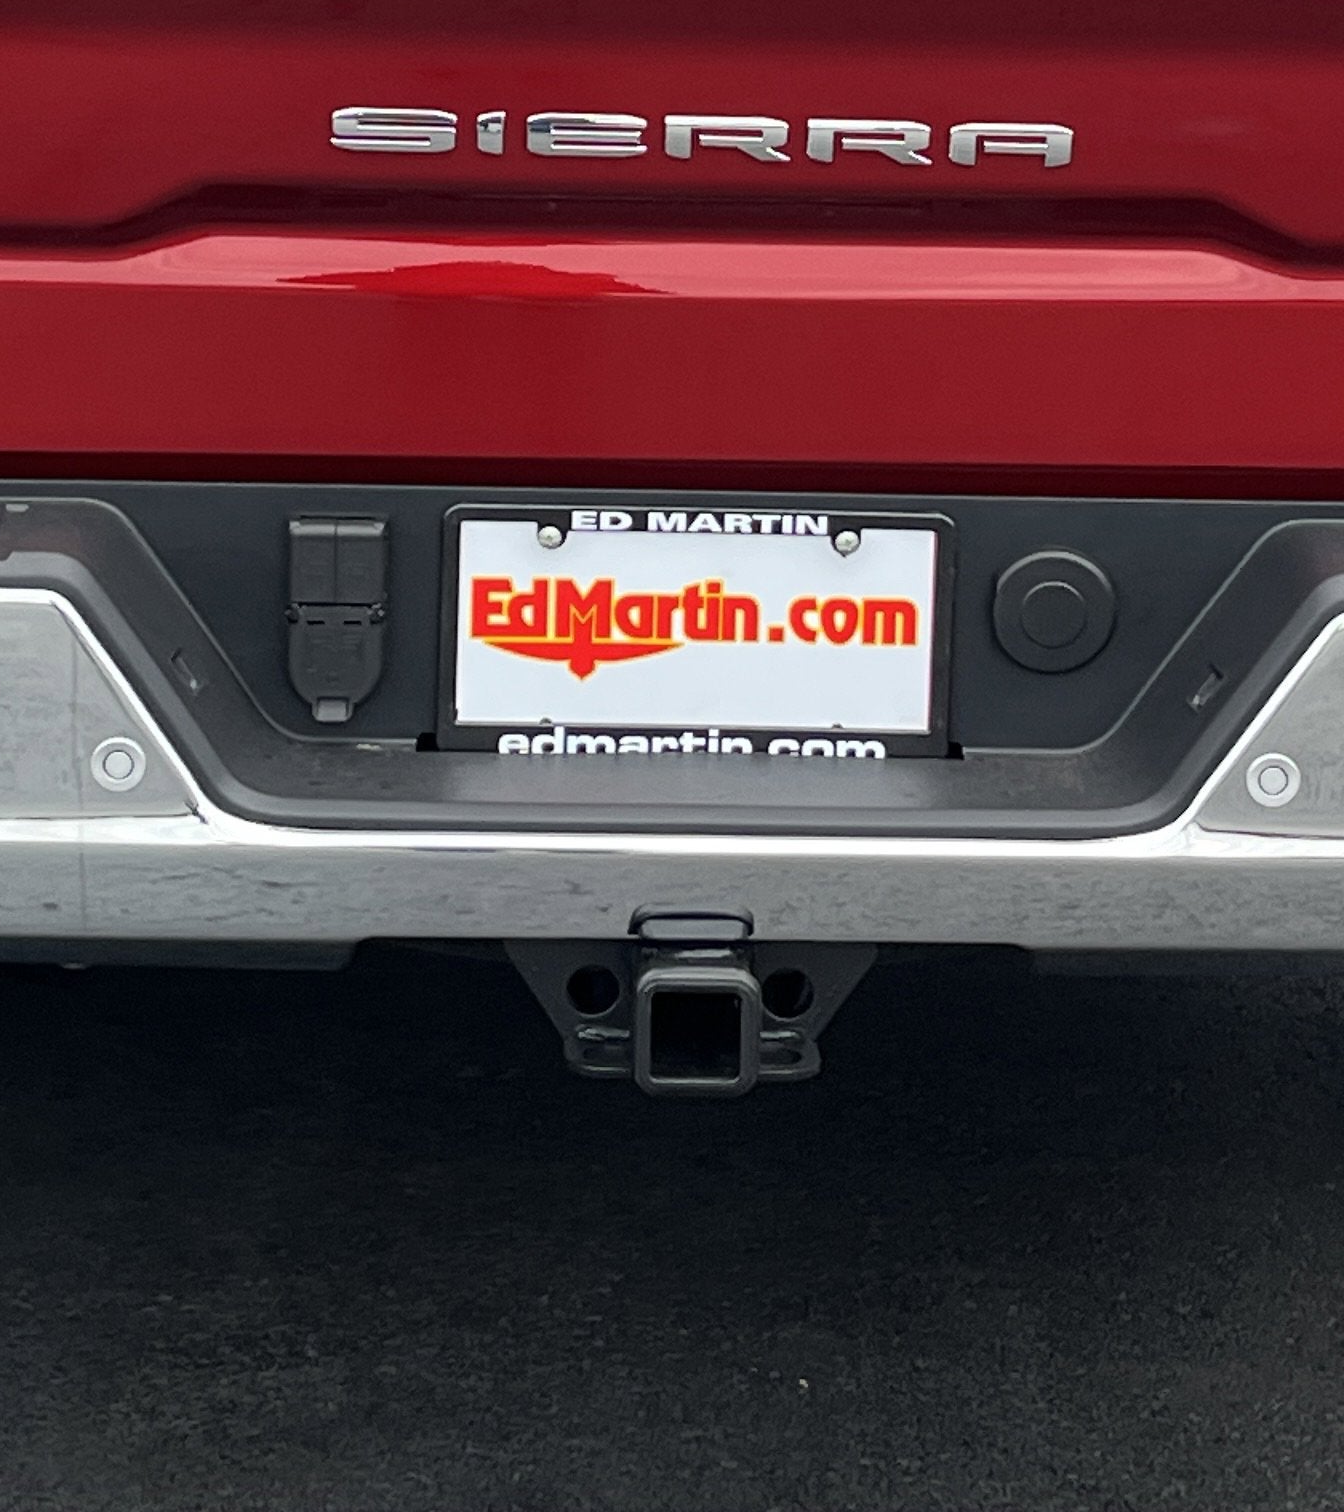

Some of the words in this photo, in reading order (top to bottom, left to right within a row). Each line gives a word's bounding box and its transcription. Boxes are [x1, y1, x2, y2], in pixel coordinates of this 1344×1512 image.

[330, 107, 1075, 167] SIERRA
[570, 510, 633, 533] ED
[646, 511, 829, 536] MARTIN
[469, 577, 920, 646] EdMartin.com
